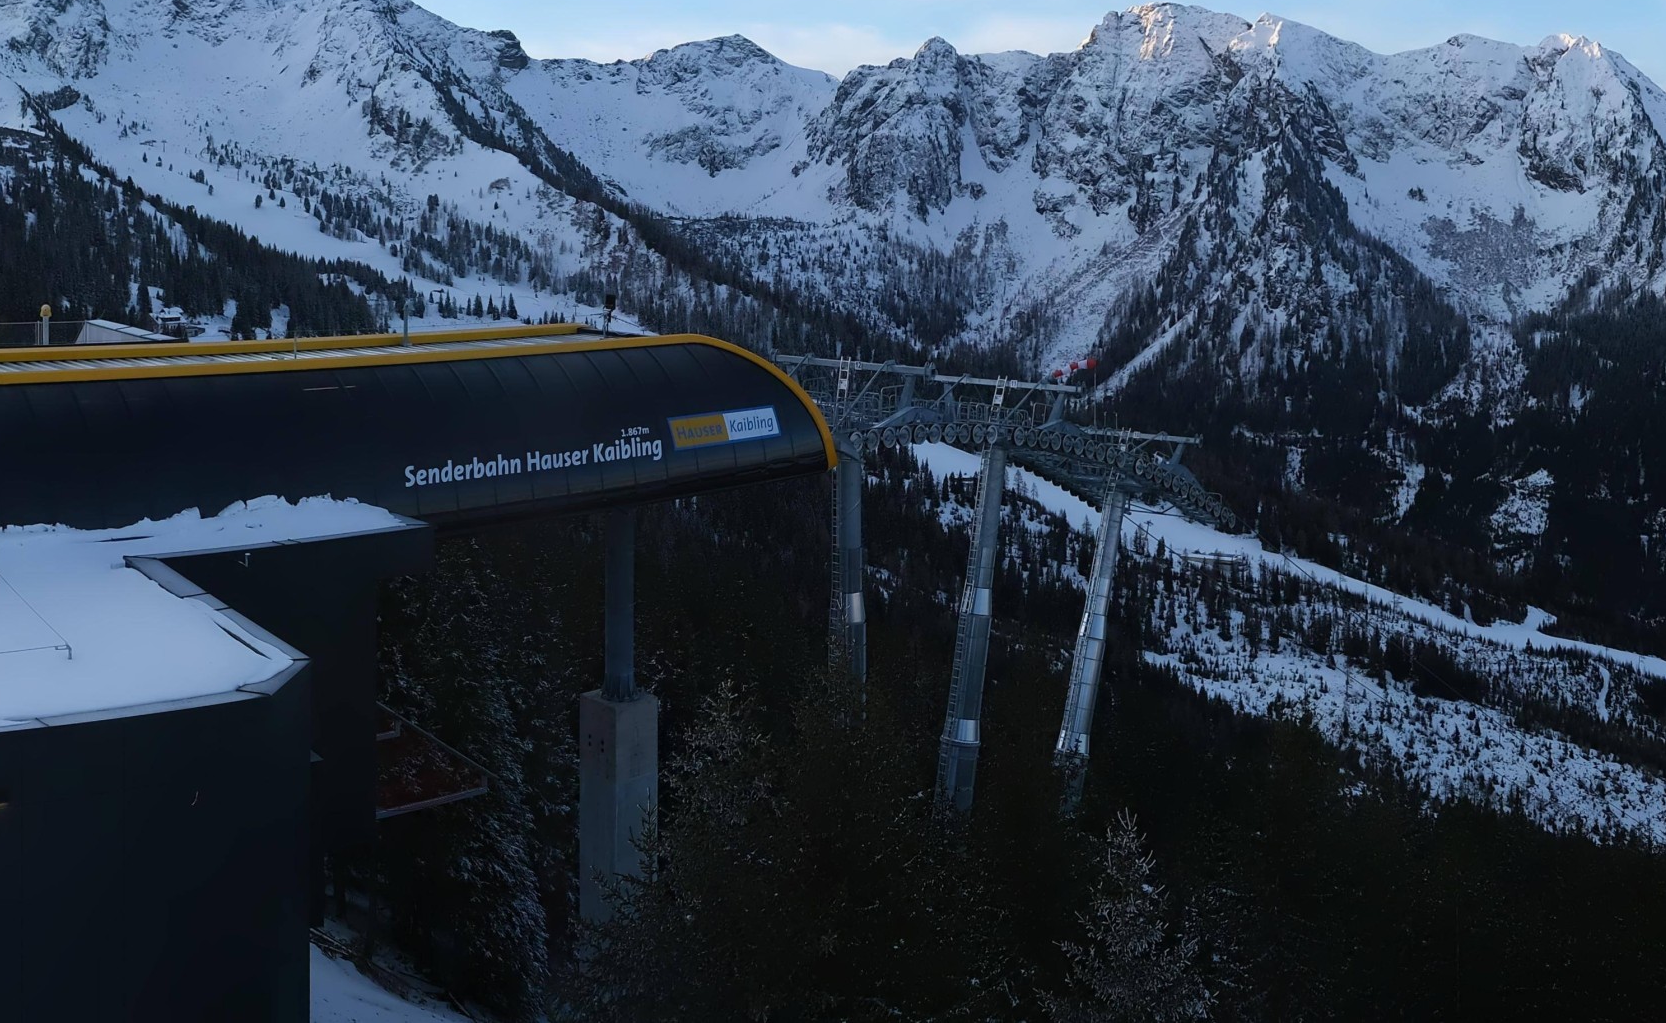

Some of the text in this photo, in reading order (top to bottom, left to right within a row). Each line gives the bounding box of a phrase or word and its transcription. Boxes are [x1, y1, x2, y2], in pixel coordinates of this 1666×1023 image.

[621, 426, 649, 437] 1.867m
[677, 416, 773, 440] HAUSER Kaibling
[404, 437, 662, 488] Senderbahn Hauser Kaibling
